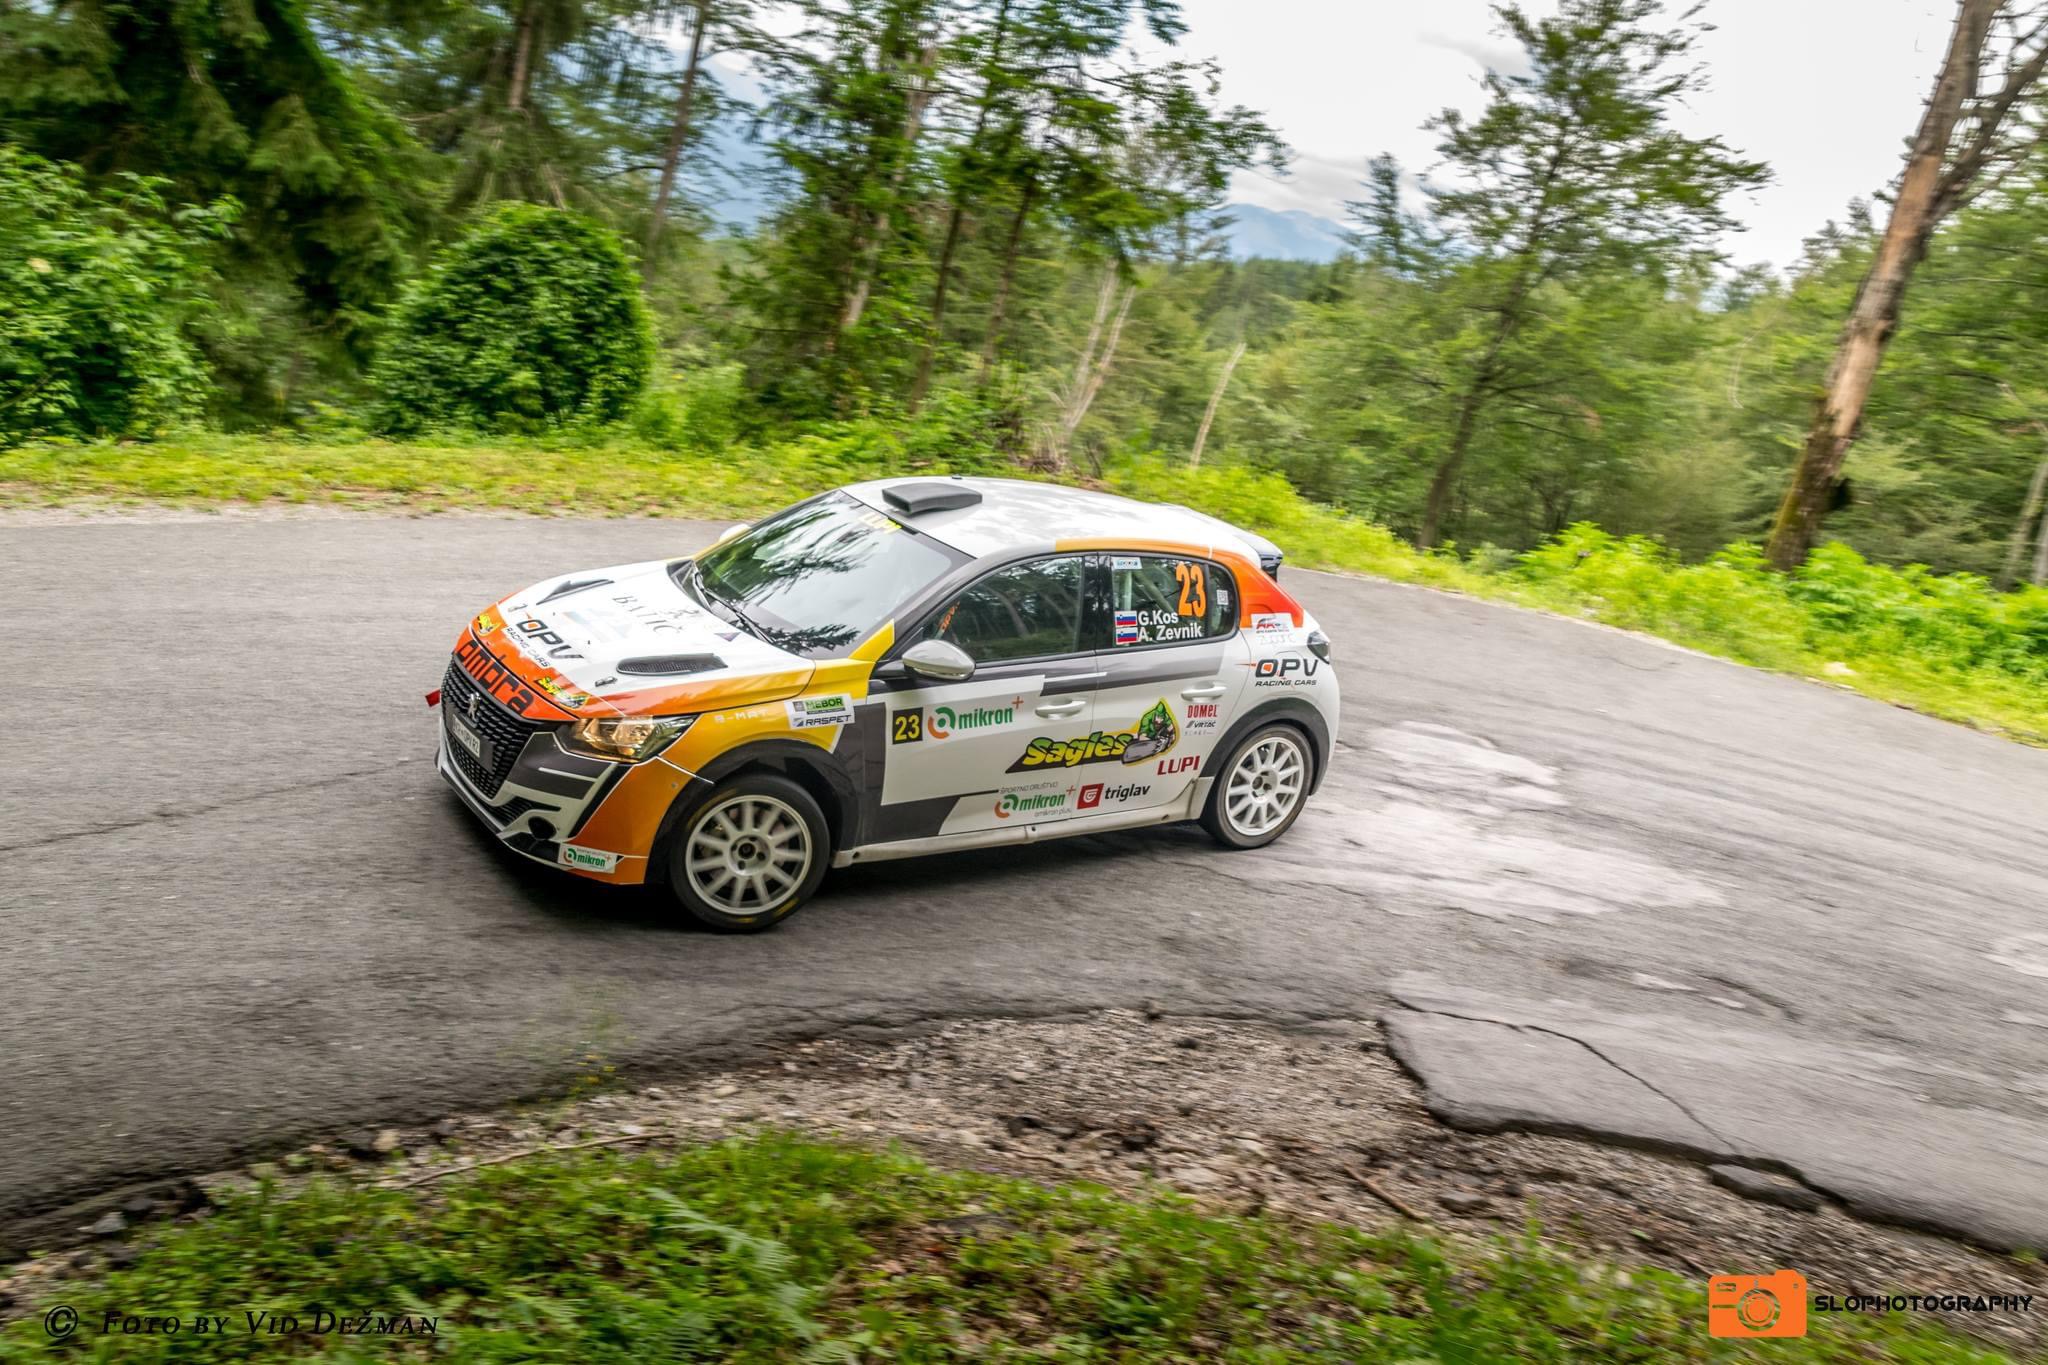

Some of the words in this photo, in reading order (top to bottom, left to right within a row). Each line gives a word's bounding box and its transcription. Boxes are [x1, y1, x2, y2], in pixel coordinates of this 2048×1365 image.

[1175, 561, 1207, 618] 23
[1138, 610, 1179, 626] G.Kos
[516, 619, 585, 660] OPV
[1138, 627, 1153, 642] A.
[1156, 622, 1203, 641] Zevnik
[1254, 658, 1319, 678] OPV
[1254, 680, 1292, 688] RACING
[805, 714, 851, 727] RASPET
[895, 714, 921, 741] 23
[1022, 731, 1135, 768] Sagles
[1157, 755, 1201, 776] LUPI
[1105, 783, 1151, 802] triglav
